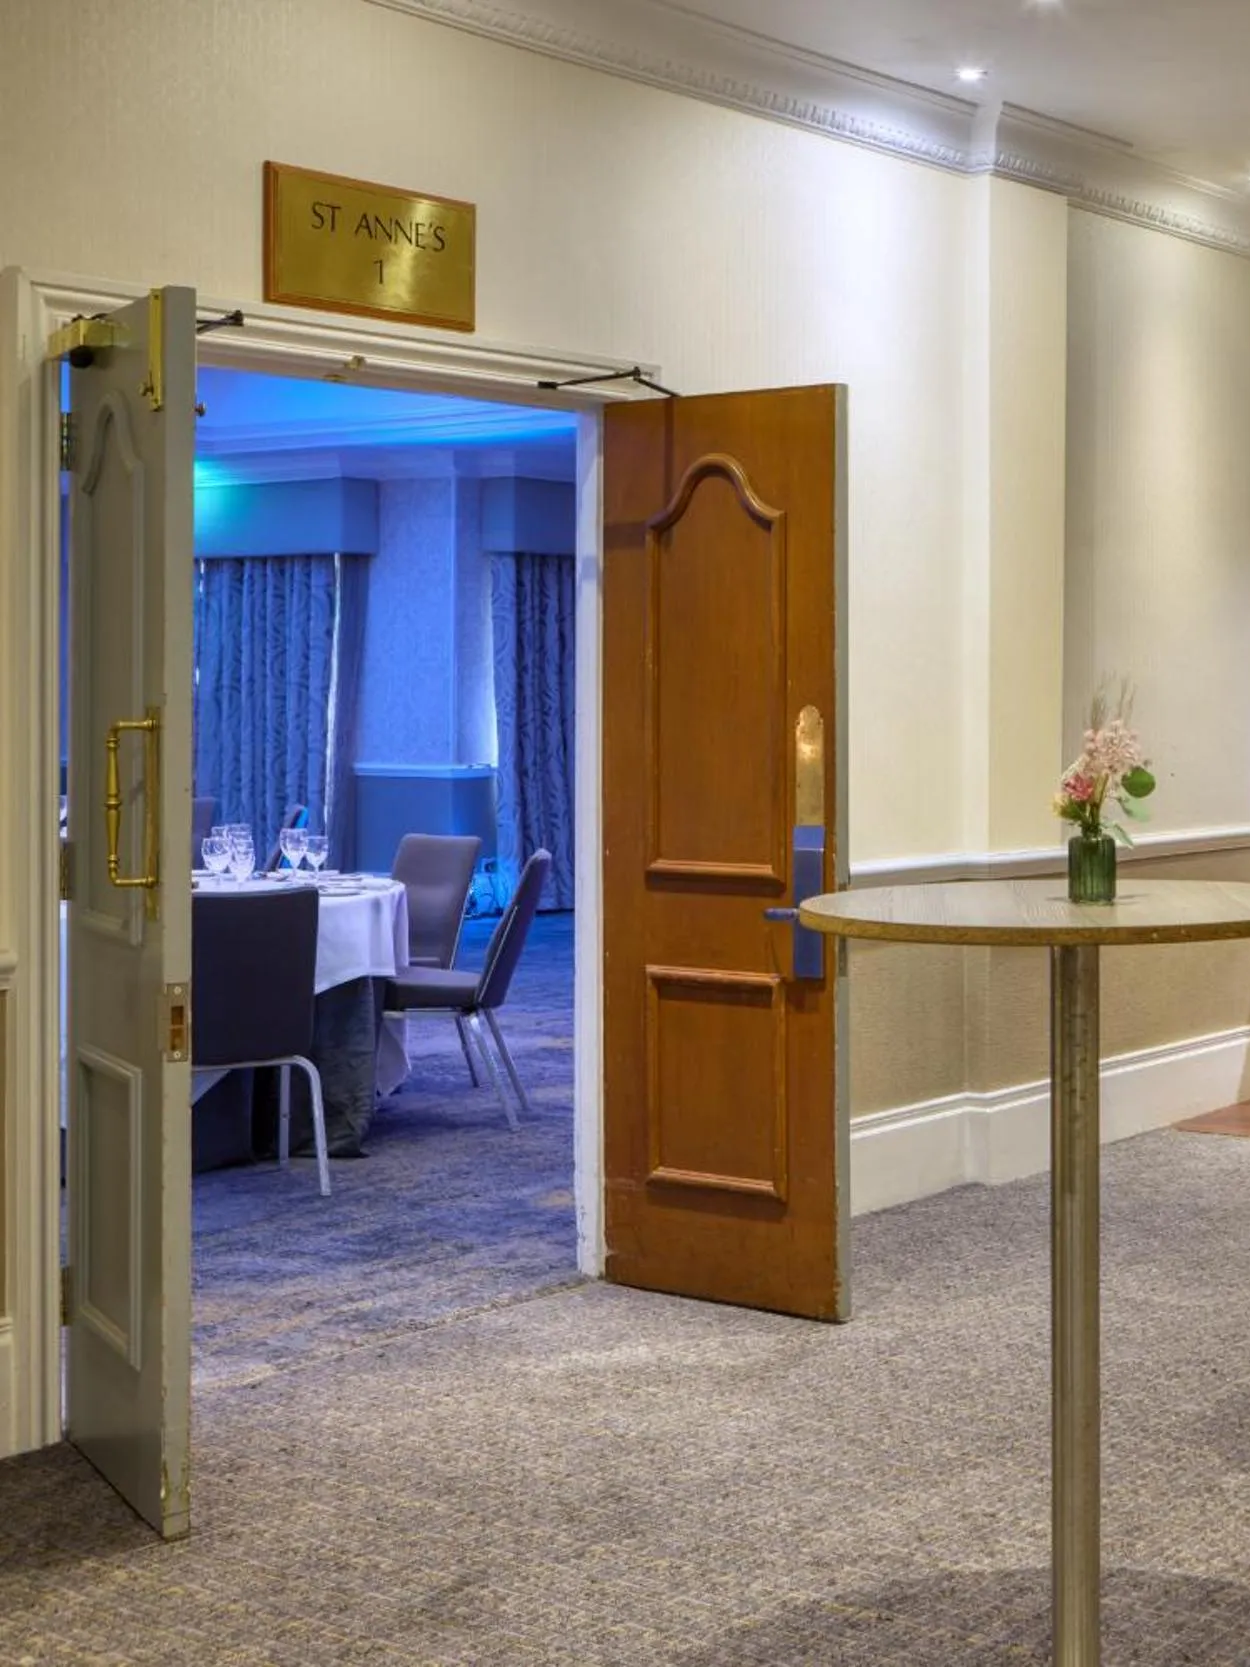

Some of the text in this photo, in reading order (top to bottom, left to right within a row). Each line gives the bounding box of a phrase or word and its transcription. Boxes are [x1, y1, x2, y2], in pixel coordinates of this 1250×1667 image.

[311, 201, 446, 252] ST ANNE'S
[373, 259, 384, 285] 1
